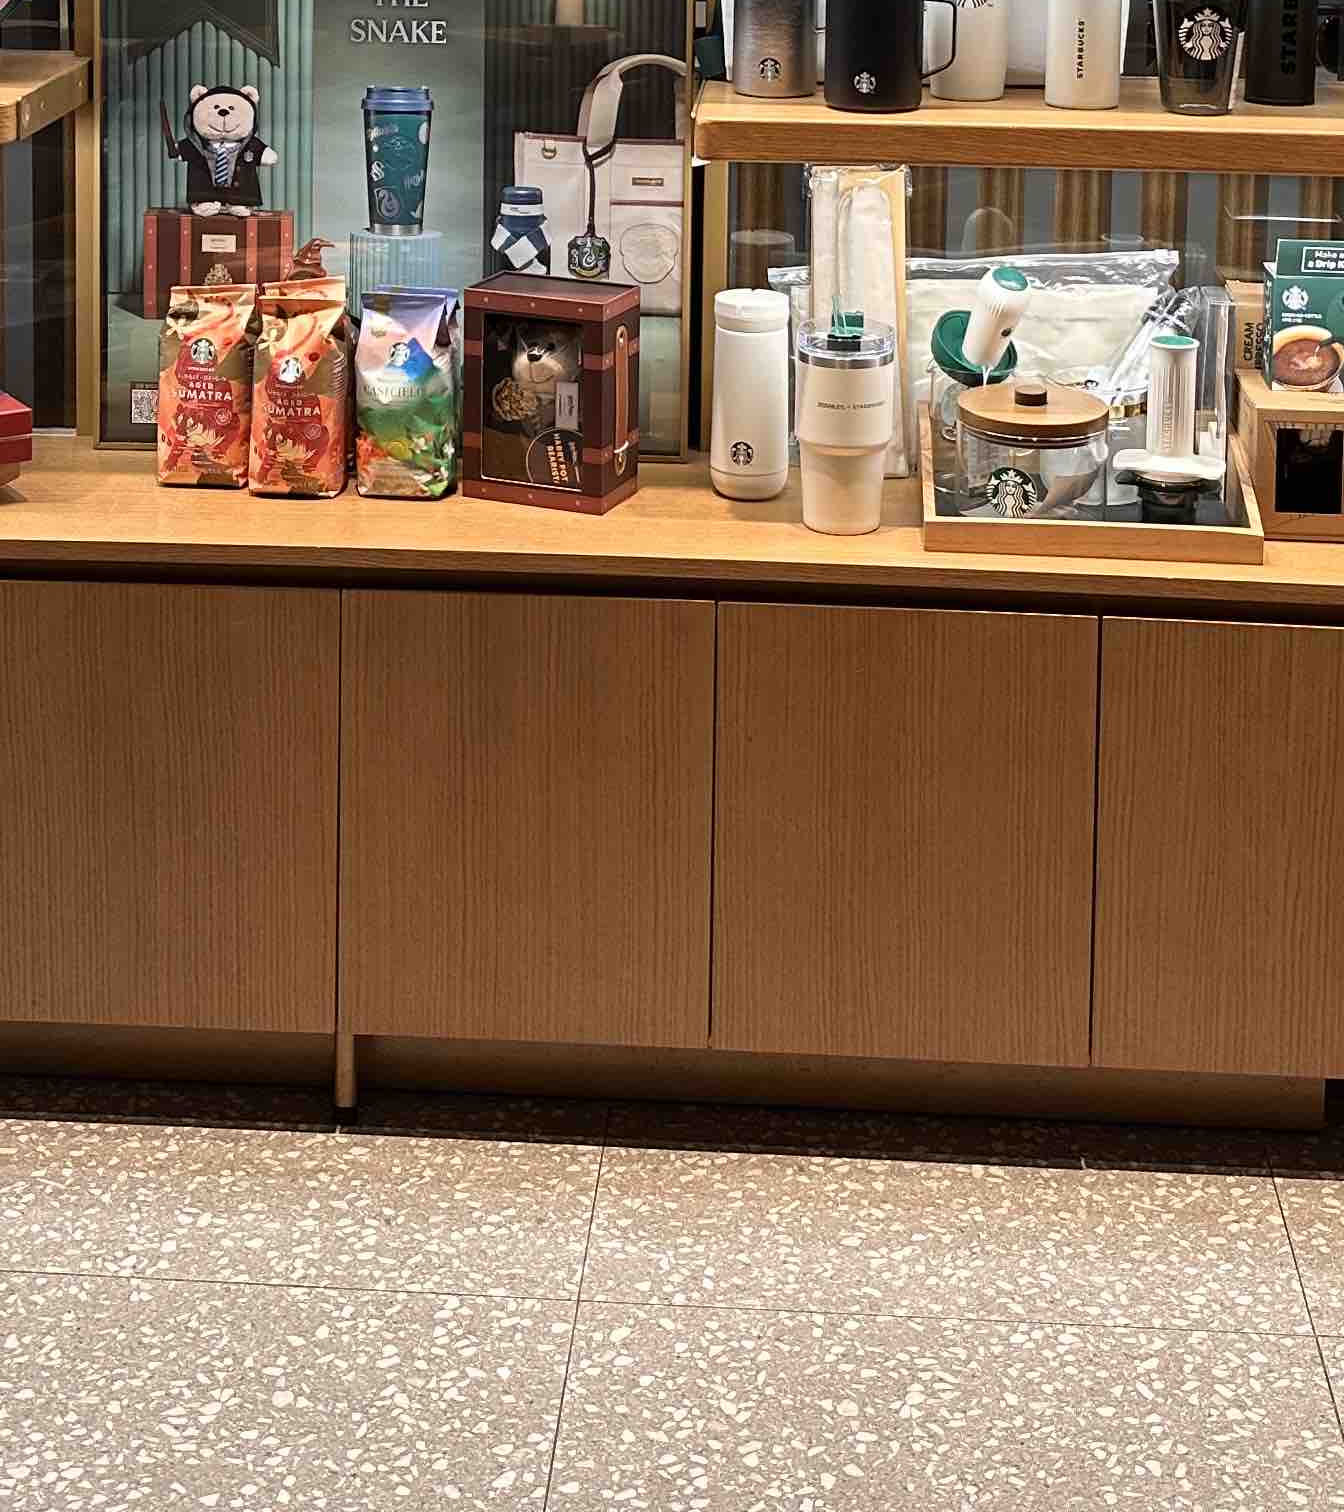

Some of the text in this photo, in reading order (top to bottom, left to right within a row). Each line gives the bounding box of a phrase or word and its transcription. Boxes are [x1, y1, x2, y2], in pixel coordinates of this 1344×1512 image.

[349, 18, 448, 45] SNAKE
[1076, 19, 1086, 80] STARBUCKS
[1314, 250, 1337, 259] Make
[1315, 259, 1337, 270] Drip
[1243, 322, 1255, 361] CREAM
